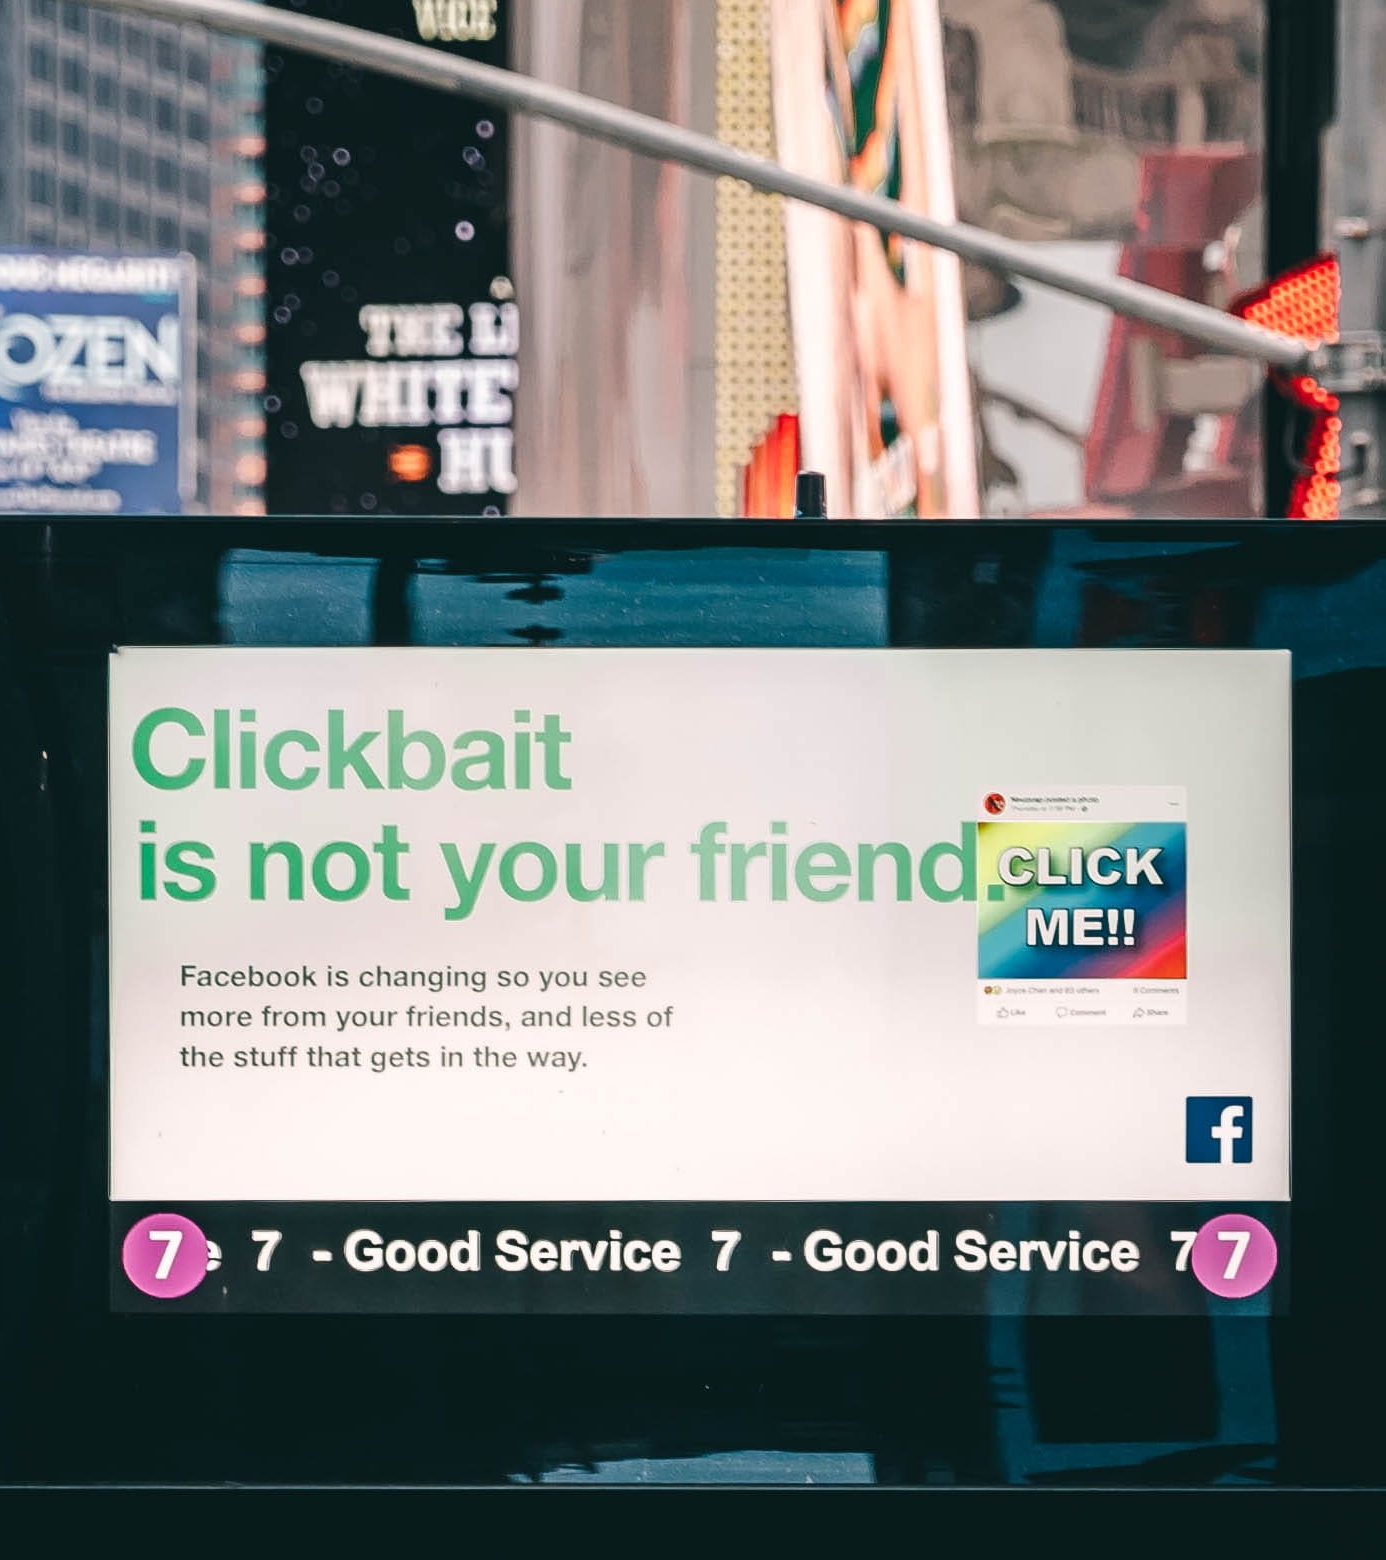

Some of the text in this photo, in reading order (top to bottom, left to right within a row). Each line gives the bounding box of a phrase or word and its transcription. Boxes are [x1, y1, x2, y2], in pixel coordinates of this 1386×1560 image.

[359, 303, 464, 357] THE
[300, 359, 520, 429] WHITE
[132, 707, 572, 791] Clickbait
[140, 822, 1004, 921] is not your friend.
[998, 847, 1164, 886] CLICK
[1026, 908, 1135, 946] ME!!
[181, 965, 646, 992] Facebook is changing so you see
[180, 1006, 673, 1032] more from your friends, and less of
[180, 1046, 587, 1073] the stuff that gets in the way.
[149, 1231, 182, 1279] 7
[252, 1230, 282, 1271] 7
[495, 1230, 681, 1272] Service
[712, 1230, 741, 1271] 7
[954, 1230, 1139, 1272] Service
[1218, 1232, 1250, 1279] 7
